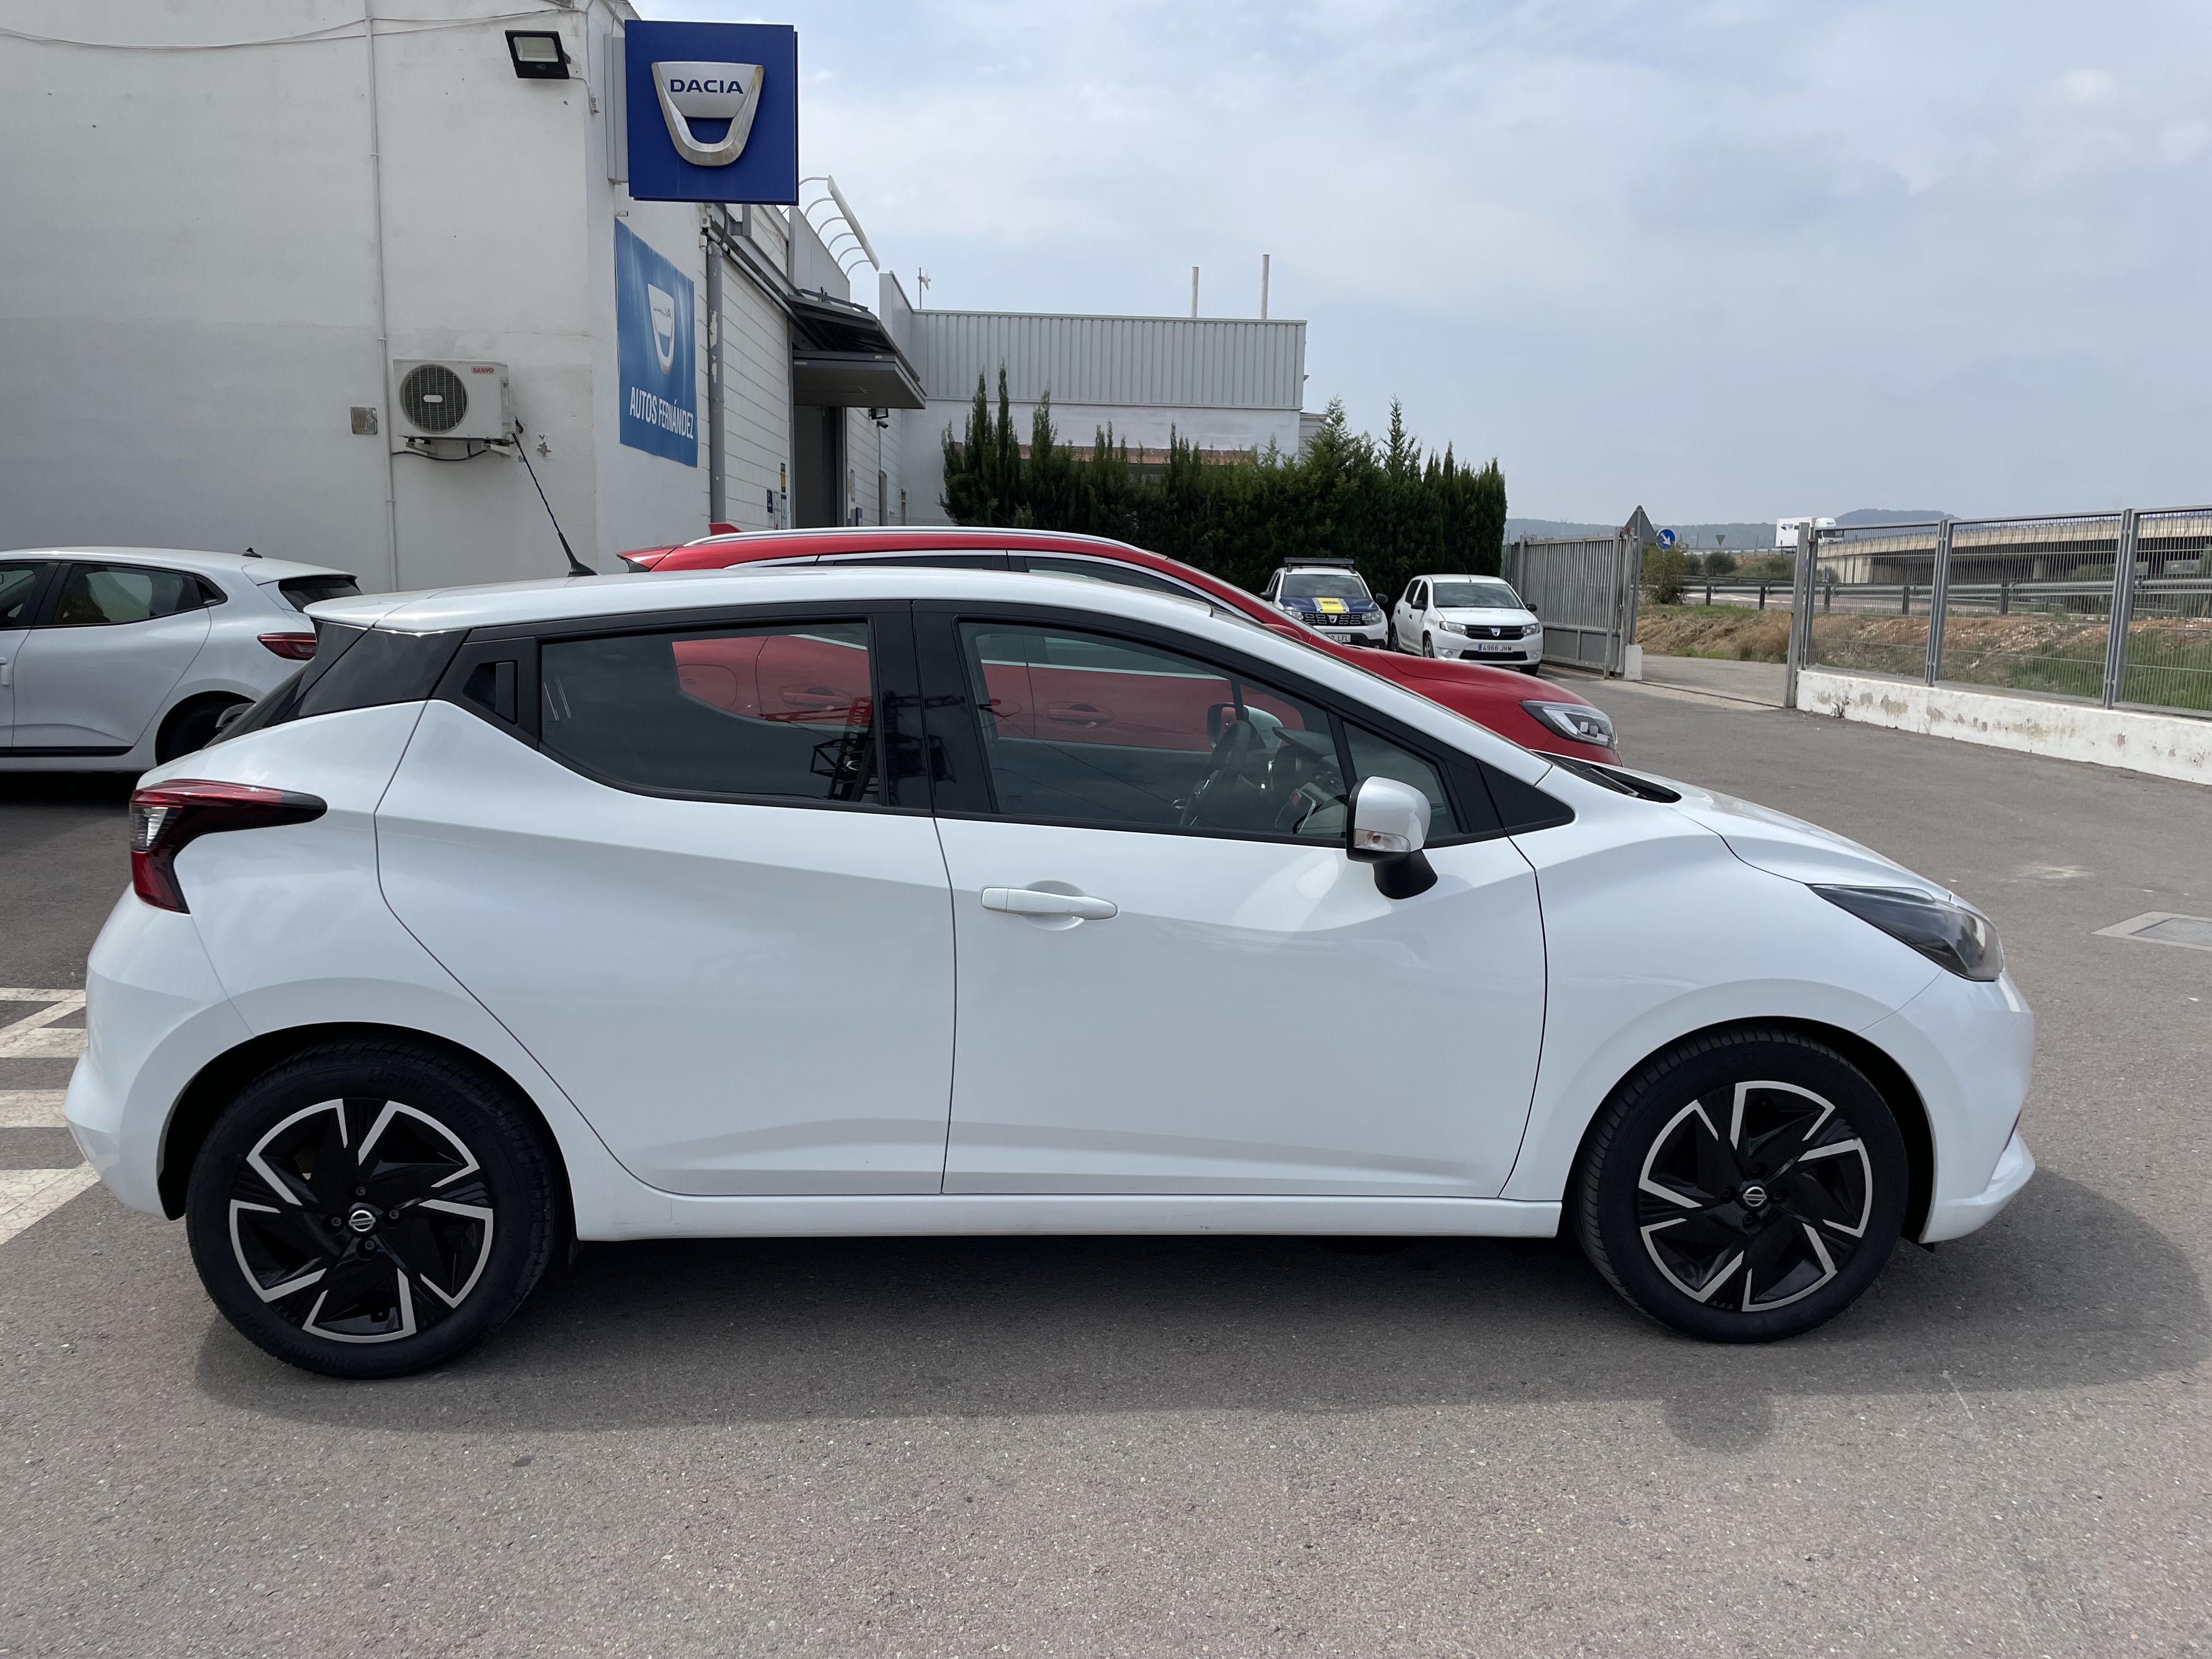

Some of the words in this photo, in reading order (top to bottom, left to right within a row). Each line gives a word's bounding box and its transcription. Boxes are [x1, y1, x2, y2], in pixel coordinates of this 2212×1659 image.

[670, 79, 744, 94] DACIA
[629, 386, 657, 425] AUTOS
[658, 398, 694, 439] FERNÁNDEZ
